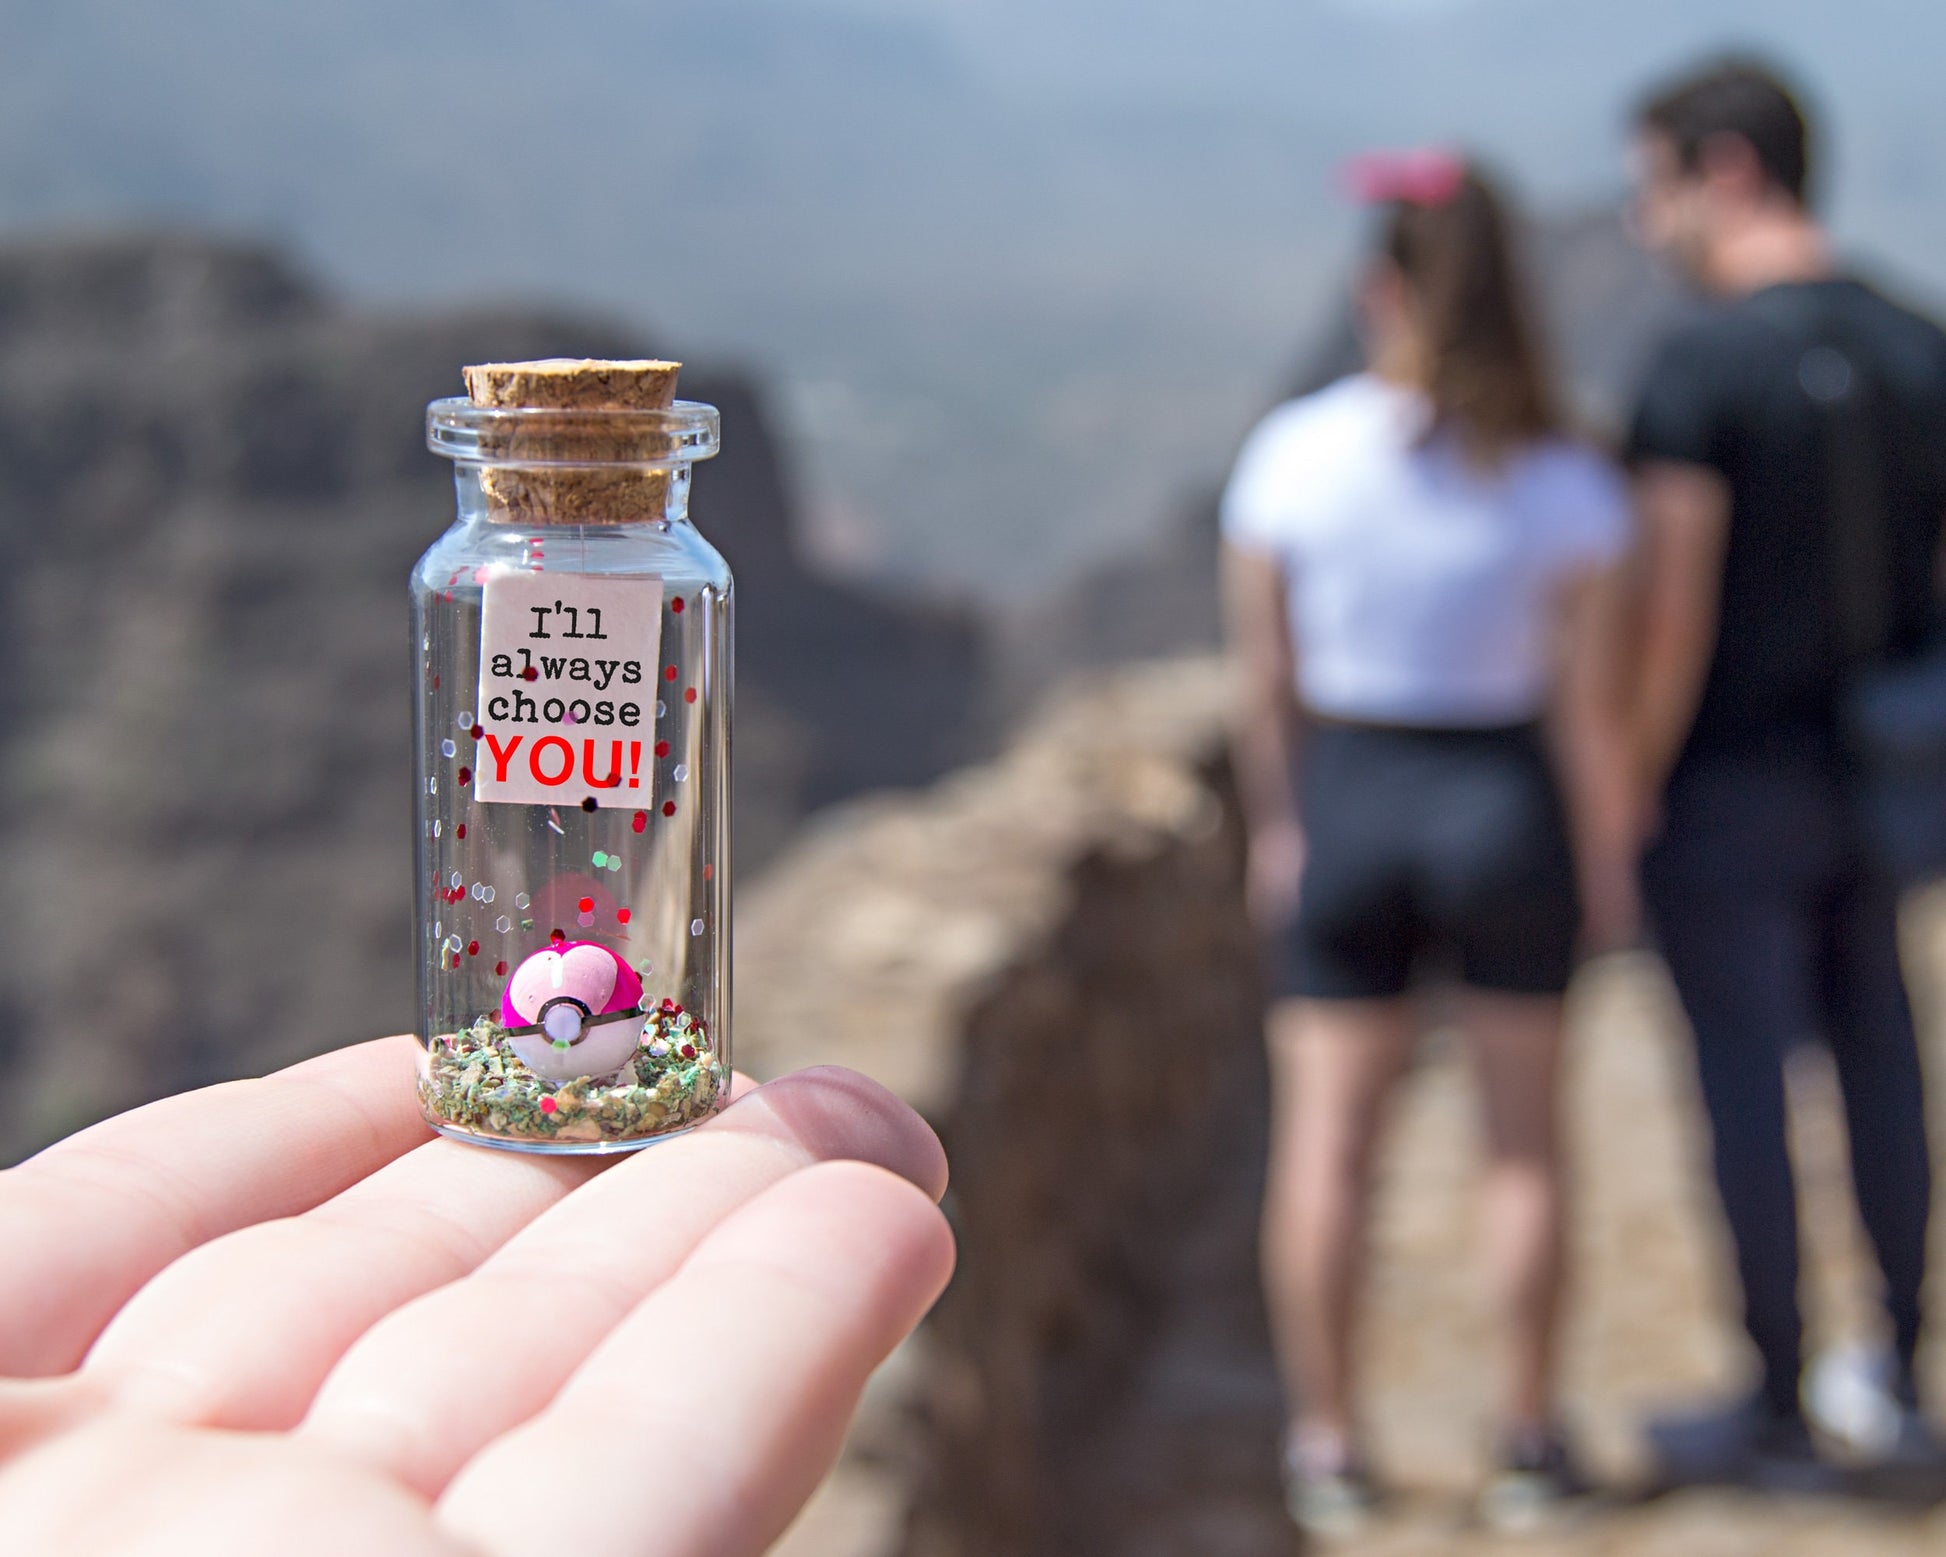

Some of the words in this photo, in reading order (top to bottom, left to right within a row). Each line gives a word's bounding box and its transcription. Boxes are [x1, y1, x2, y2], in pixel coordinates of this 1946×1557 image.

[529, 600, 607, 639] I'll
[491, 648, 642, 690] always
[488, 689, 641, 727] choose
[484, 734, 642, 788] YOU!
